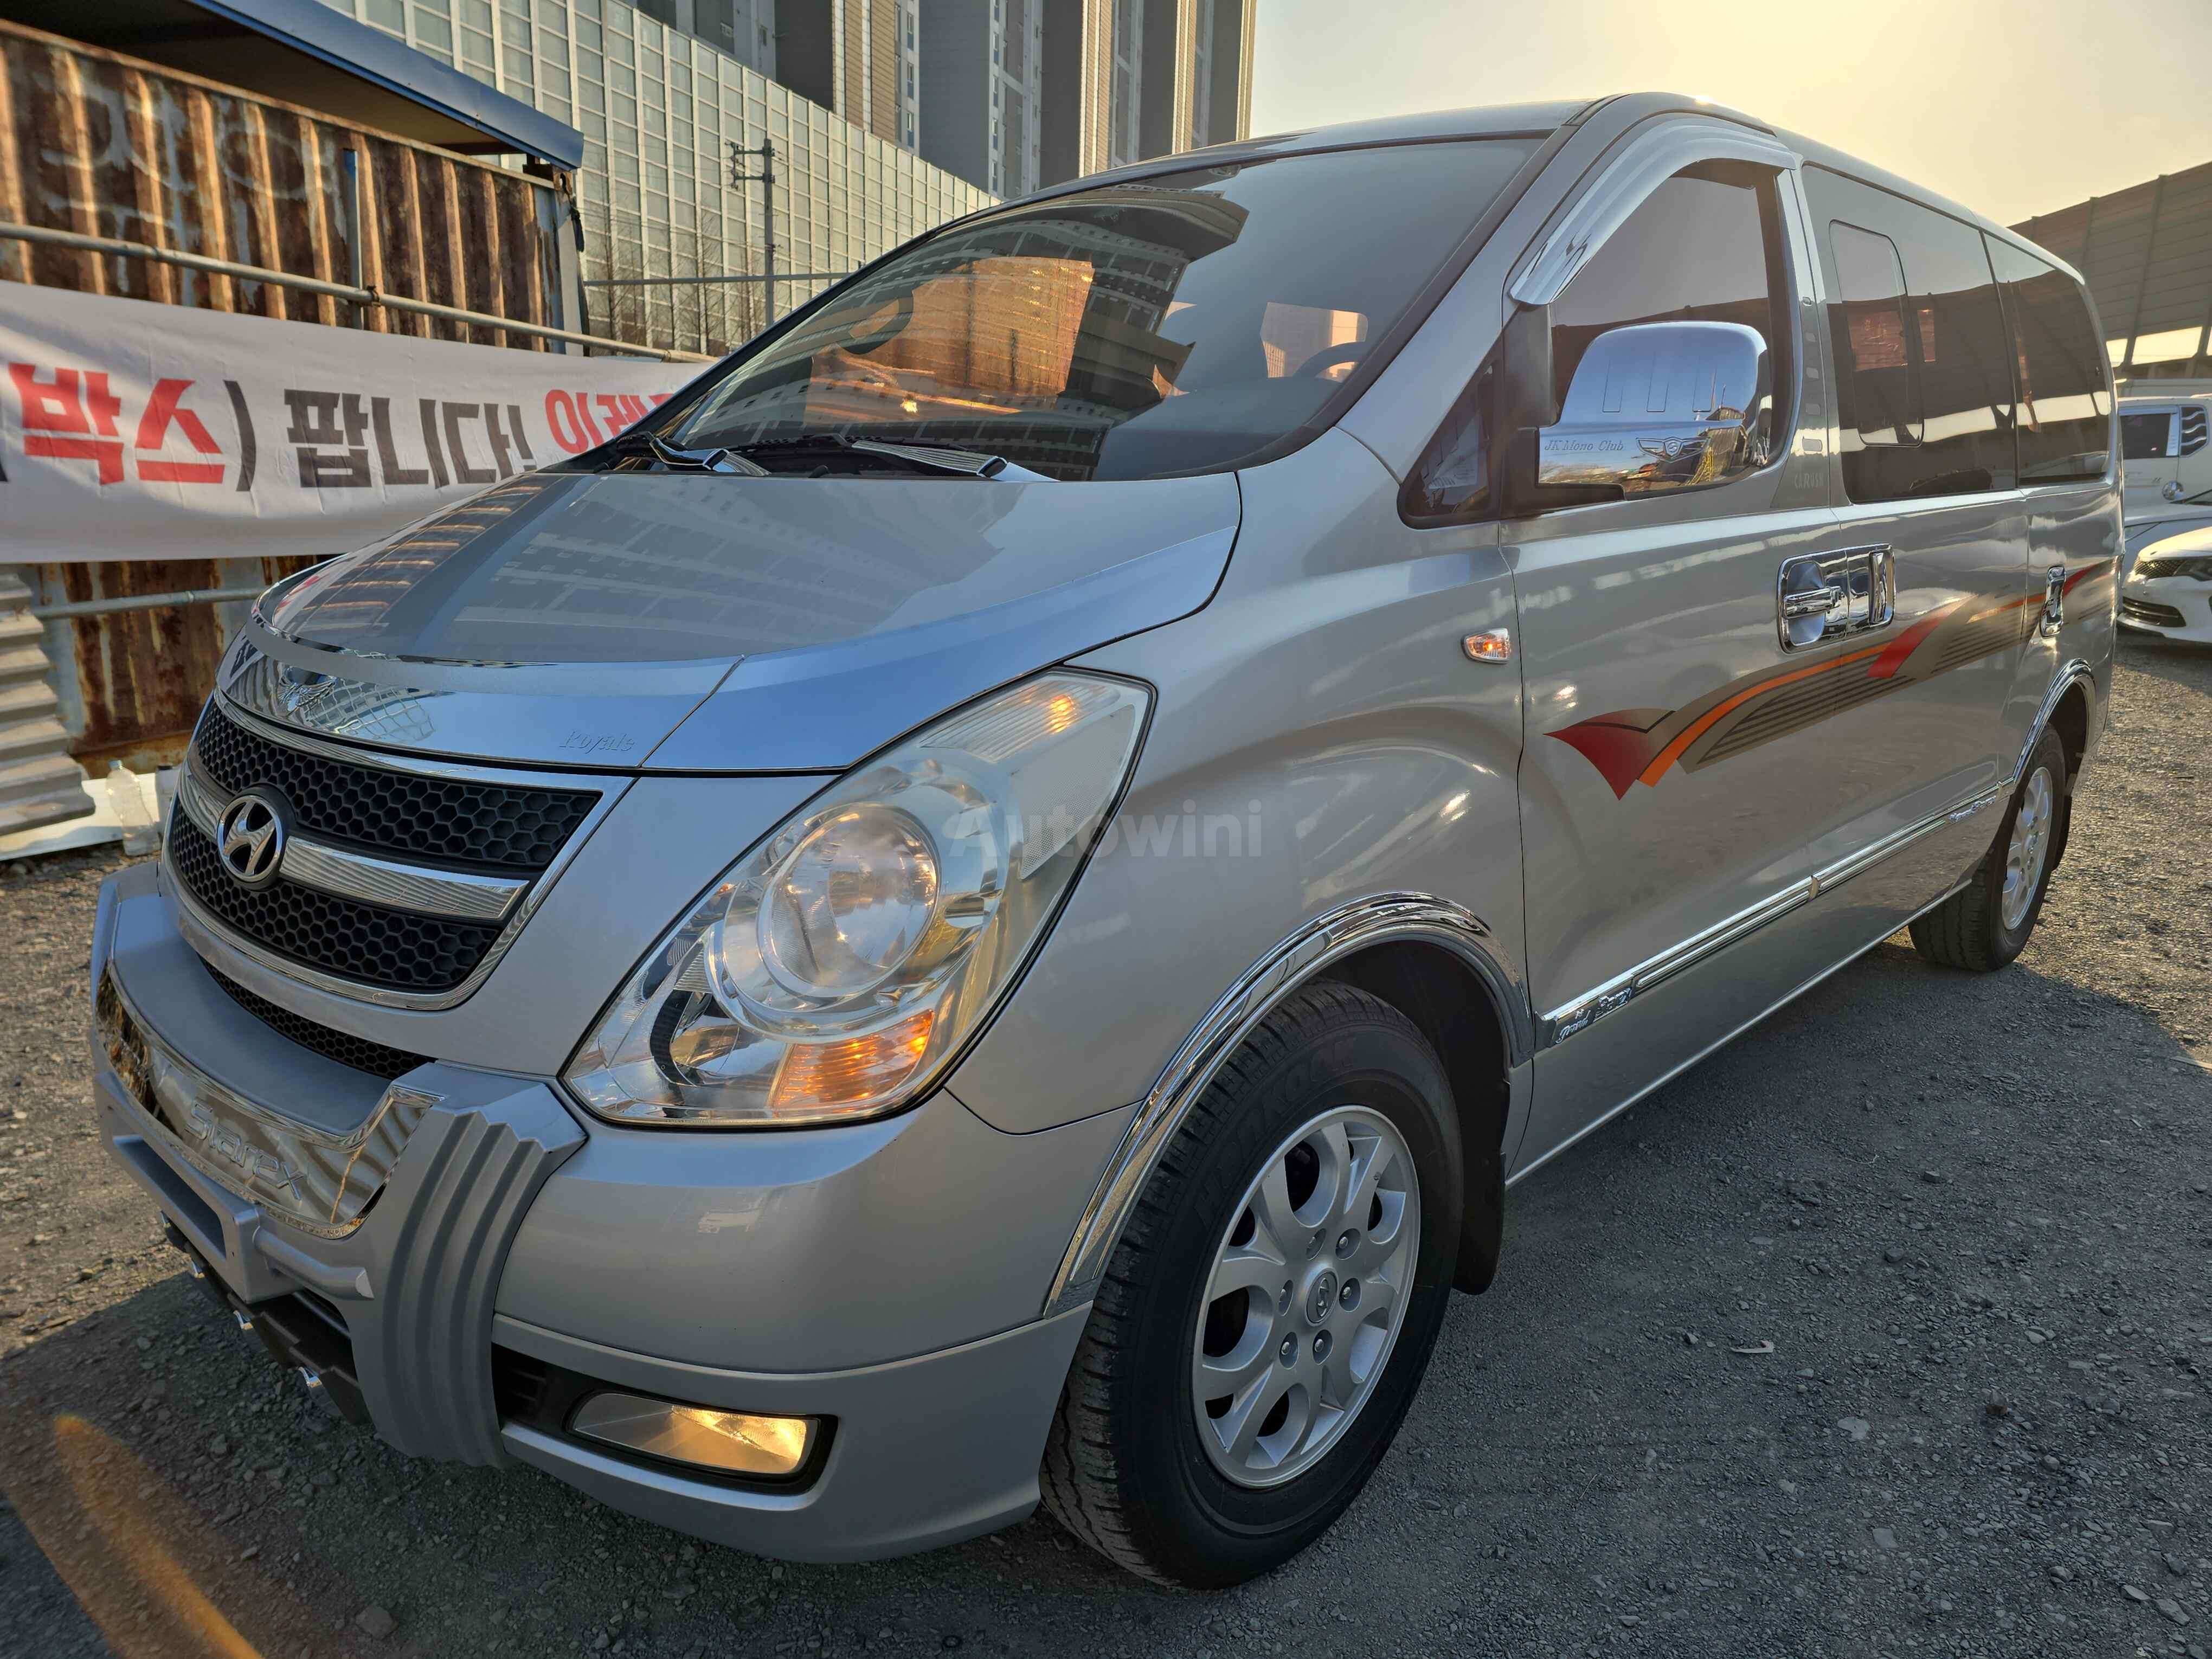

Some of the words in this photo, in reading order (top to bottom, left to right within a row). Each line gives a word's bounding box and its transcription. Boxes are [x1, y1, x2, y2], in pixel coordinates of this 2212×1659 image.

[0, 362, 256, 492] 박스)
[284, 388, 537, 490] 팝니다!
[1598, 438, 1624, 451] Club
